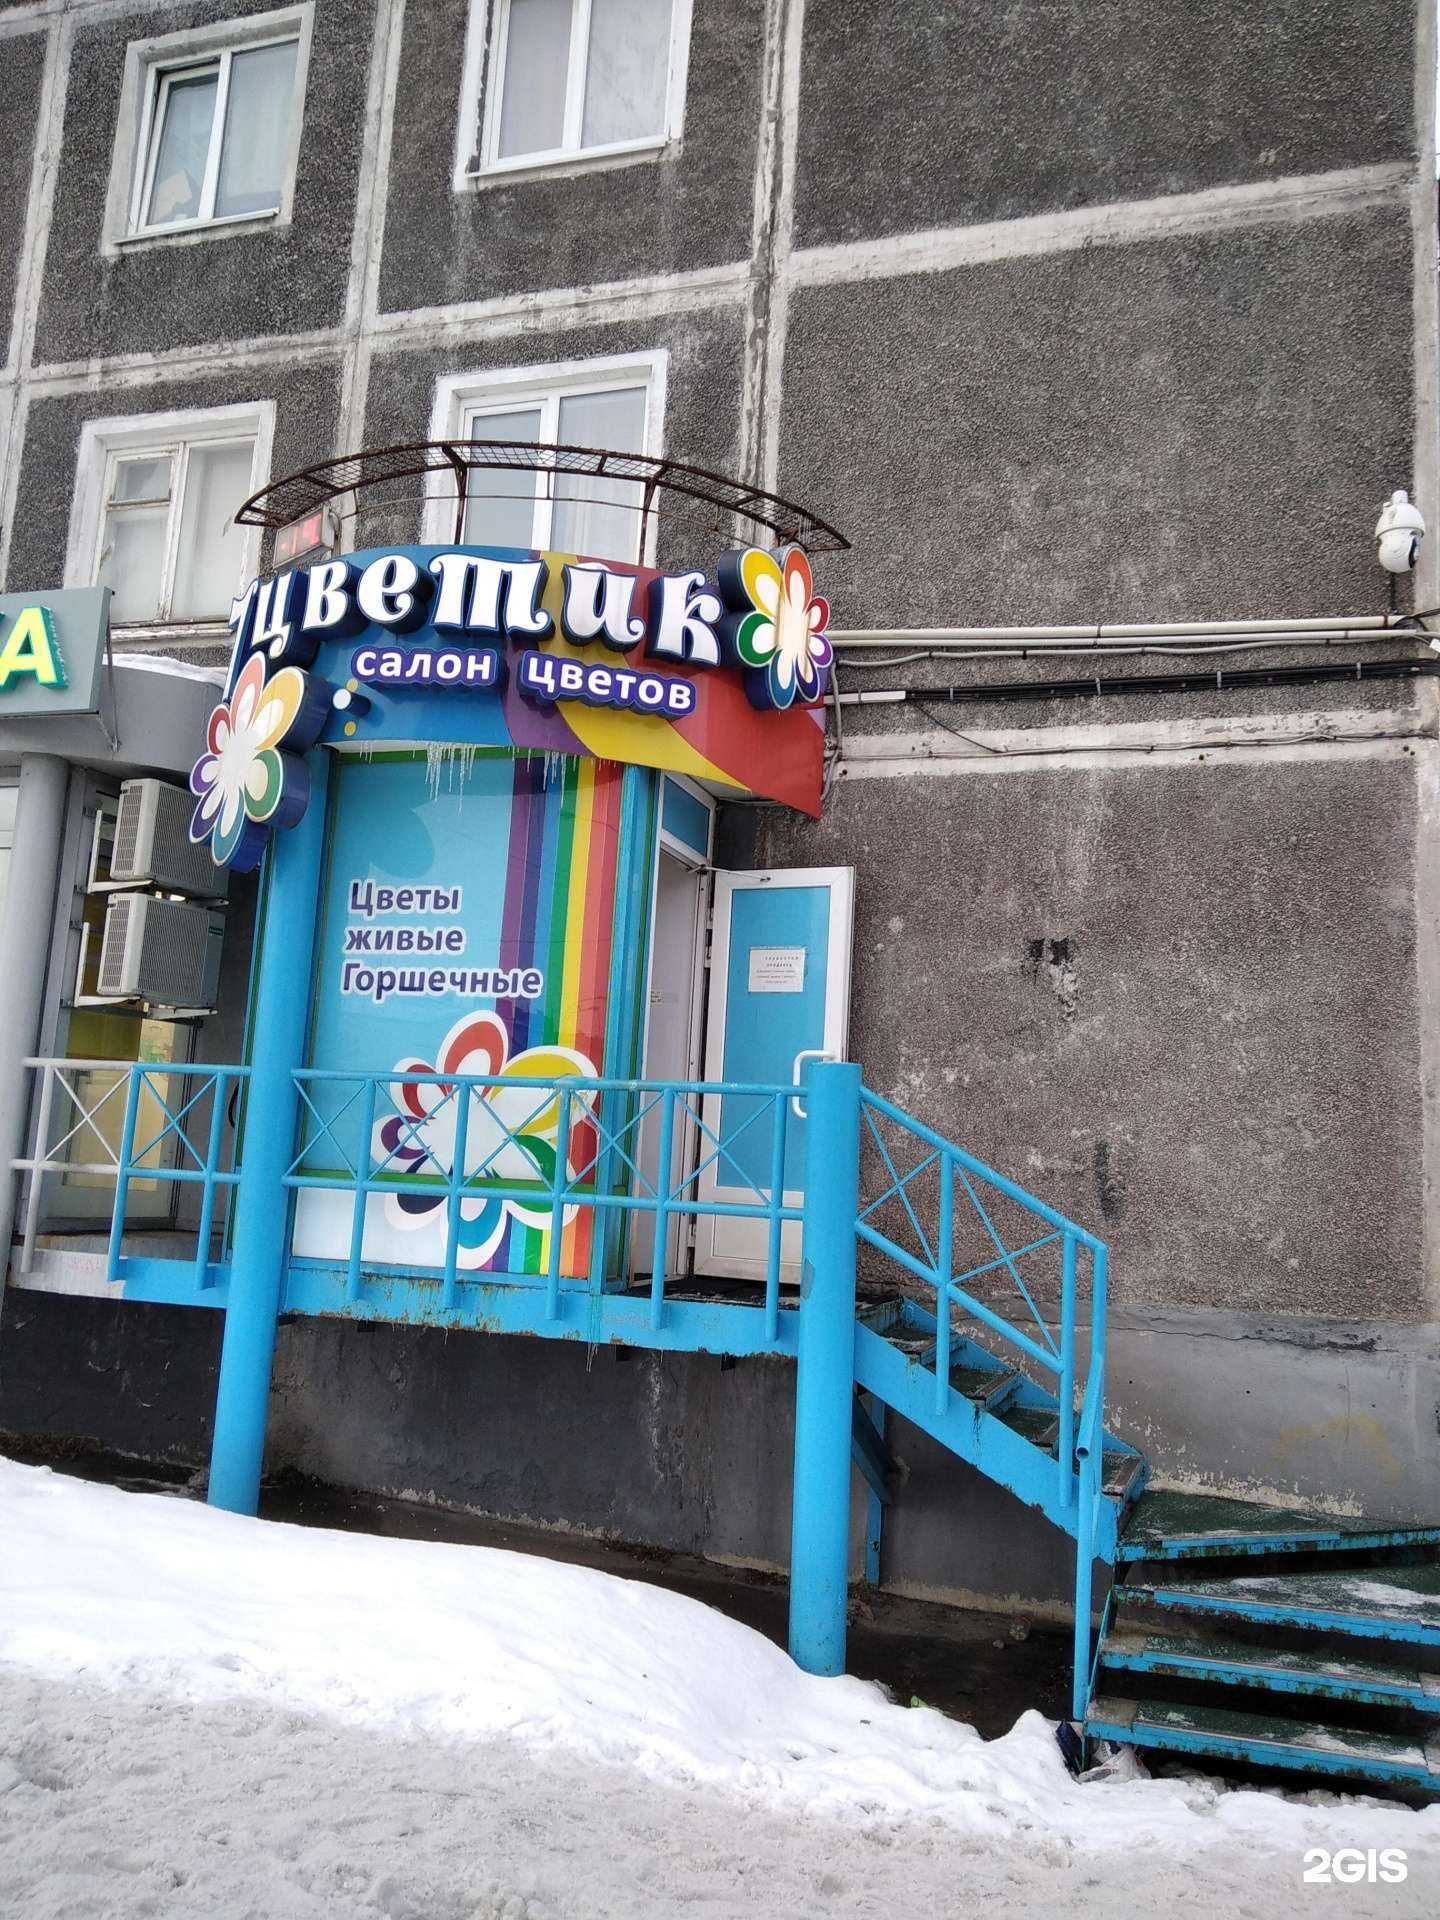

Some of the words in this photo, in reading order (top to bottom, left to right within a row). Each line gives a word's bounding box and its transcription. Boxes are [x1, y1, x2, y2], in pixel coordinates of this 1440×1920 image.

[355, 650, 492, 681] салон
[528, 656, 692, 711] цветов
[350, 882, 460, 917] Цветы
[345, 929, 464, 952] живые
[342, 962, 542, 1001] Горшечные
